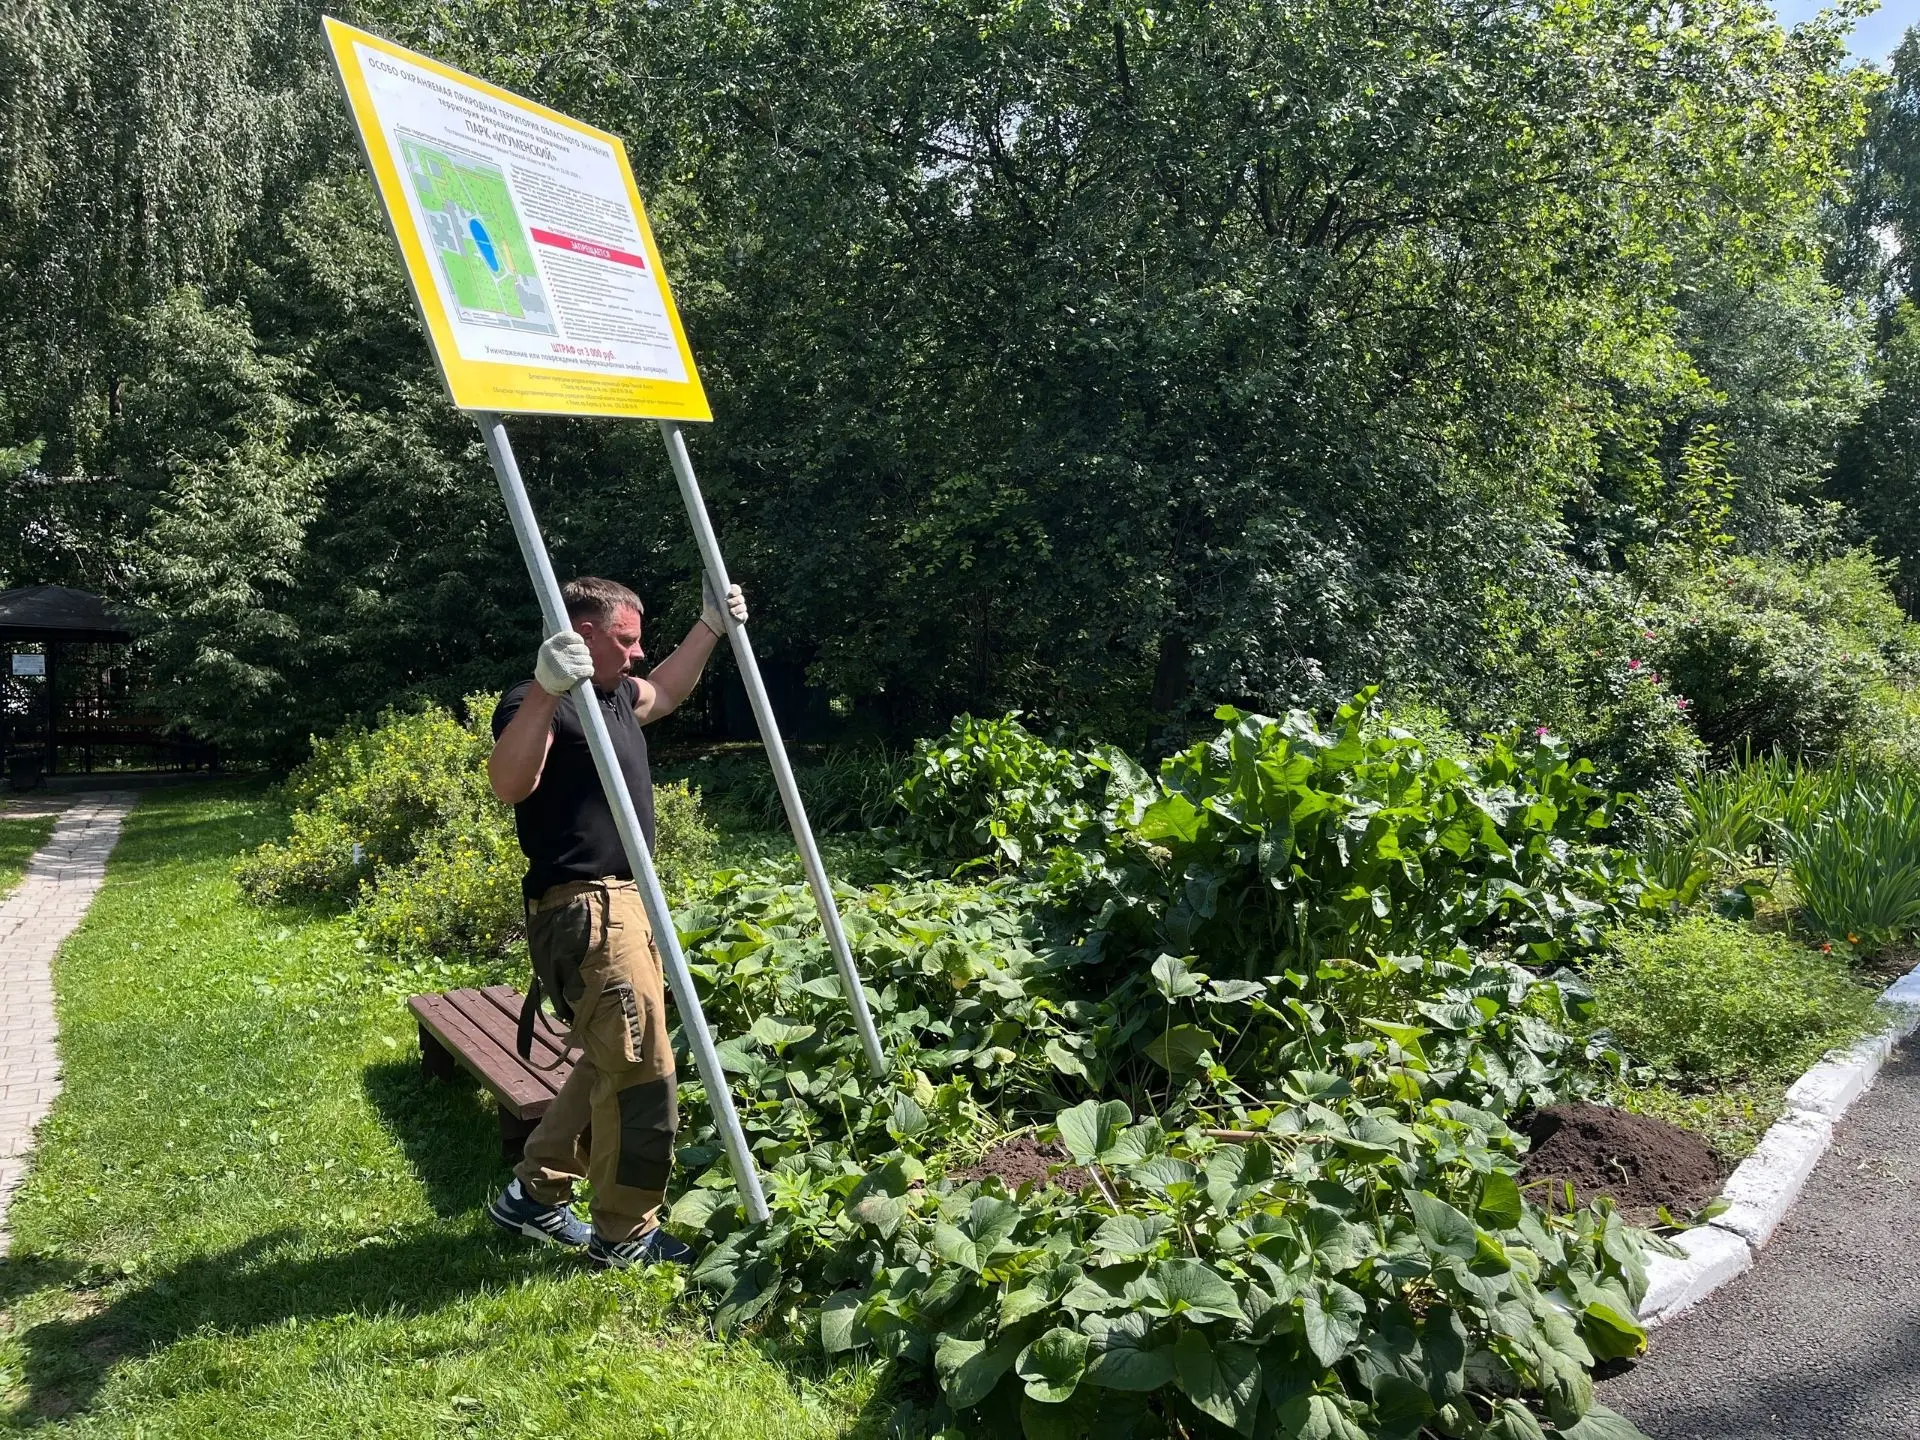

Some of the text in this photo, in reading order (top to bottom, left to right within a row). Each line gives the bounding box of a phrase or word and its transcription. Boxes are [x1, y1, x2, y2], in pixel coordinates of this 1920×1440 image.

[368, 58, 399, 77] ОСОБО
[400, 70, 453, 98] ОХРАНЯЕМАЯ
[454, 91, 498, 116] ПРИРОДНАЯ
[499, 109, 540, 132] ТЕРРИТОРИЯ
[540, 126, 580, 147] ОБЛАСТНОГО
[440, 99, 480, 121] территория
[465, 120, 557, 162] ПАРК «ИГУМЕНСКИЙ»
[570, 241, 611, 259] ЗАПРЕЩАЕТСЯ
[551, 343, 576, 355] ШТРАФ
[577, 347, 585, 356] от
[585, 346, 591, 357] 3
[590, 348, 602, 358] 000
